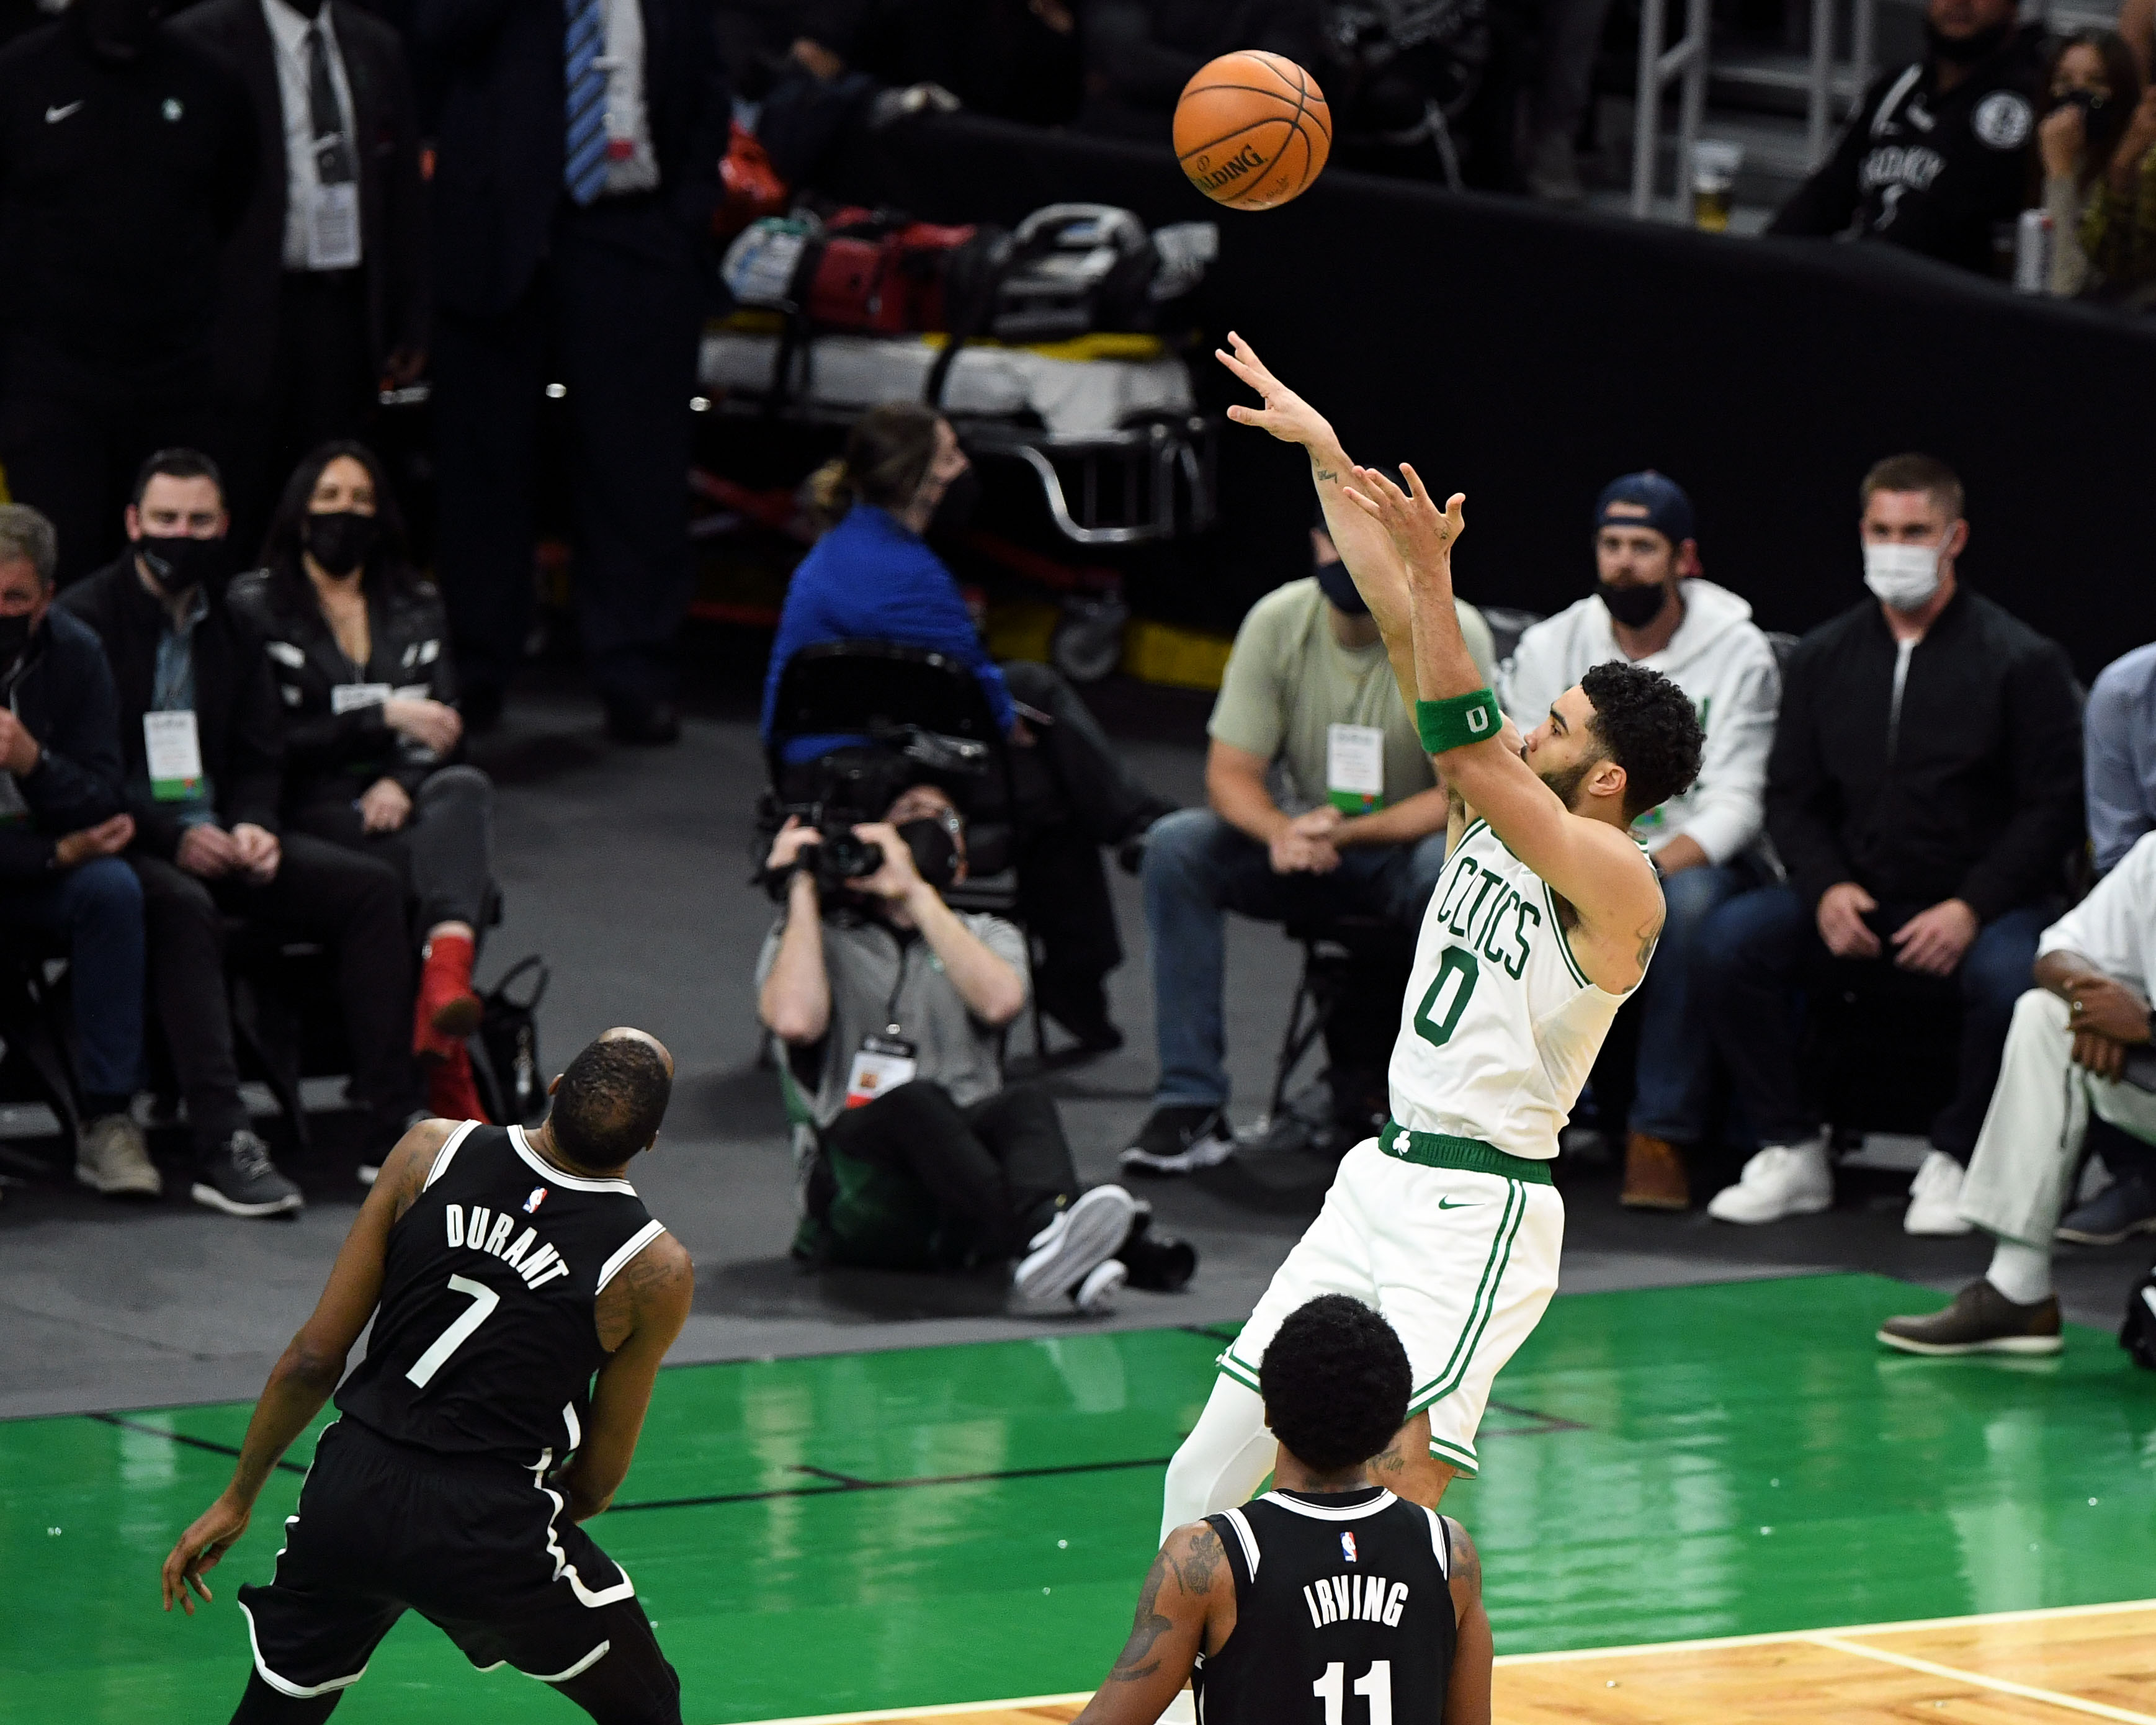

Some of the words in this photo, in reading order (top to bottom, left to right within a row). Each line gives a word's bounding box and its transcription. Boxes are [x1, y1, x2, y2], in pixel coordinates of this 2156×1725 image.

[1413, 945, 1480, 1047] 0
[446, 1204, 570, 1290] DURANT
[405, 1273, 501, 1389] 7
[1303, 1574, 1409, 1629] IRVING
[1313, 1660, 1392, 1725] 11
